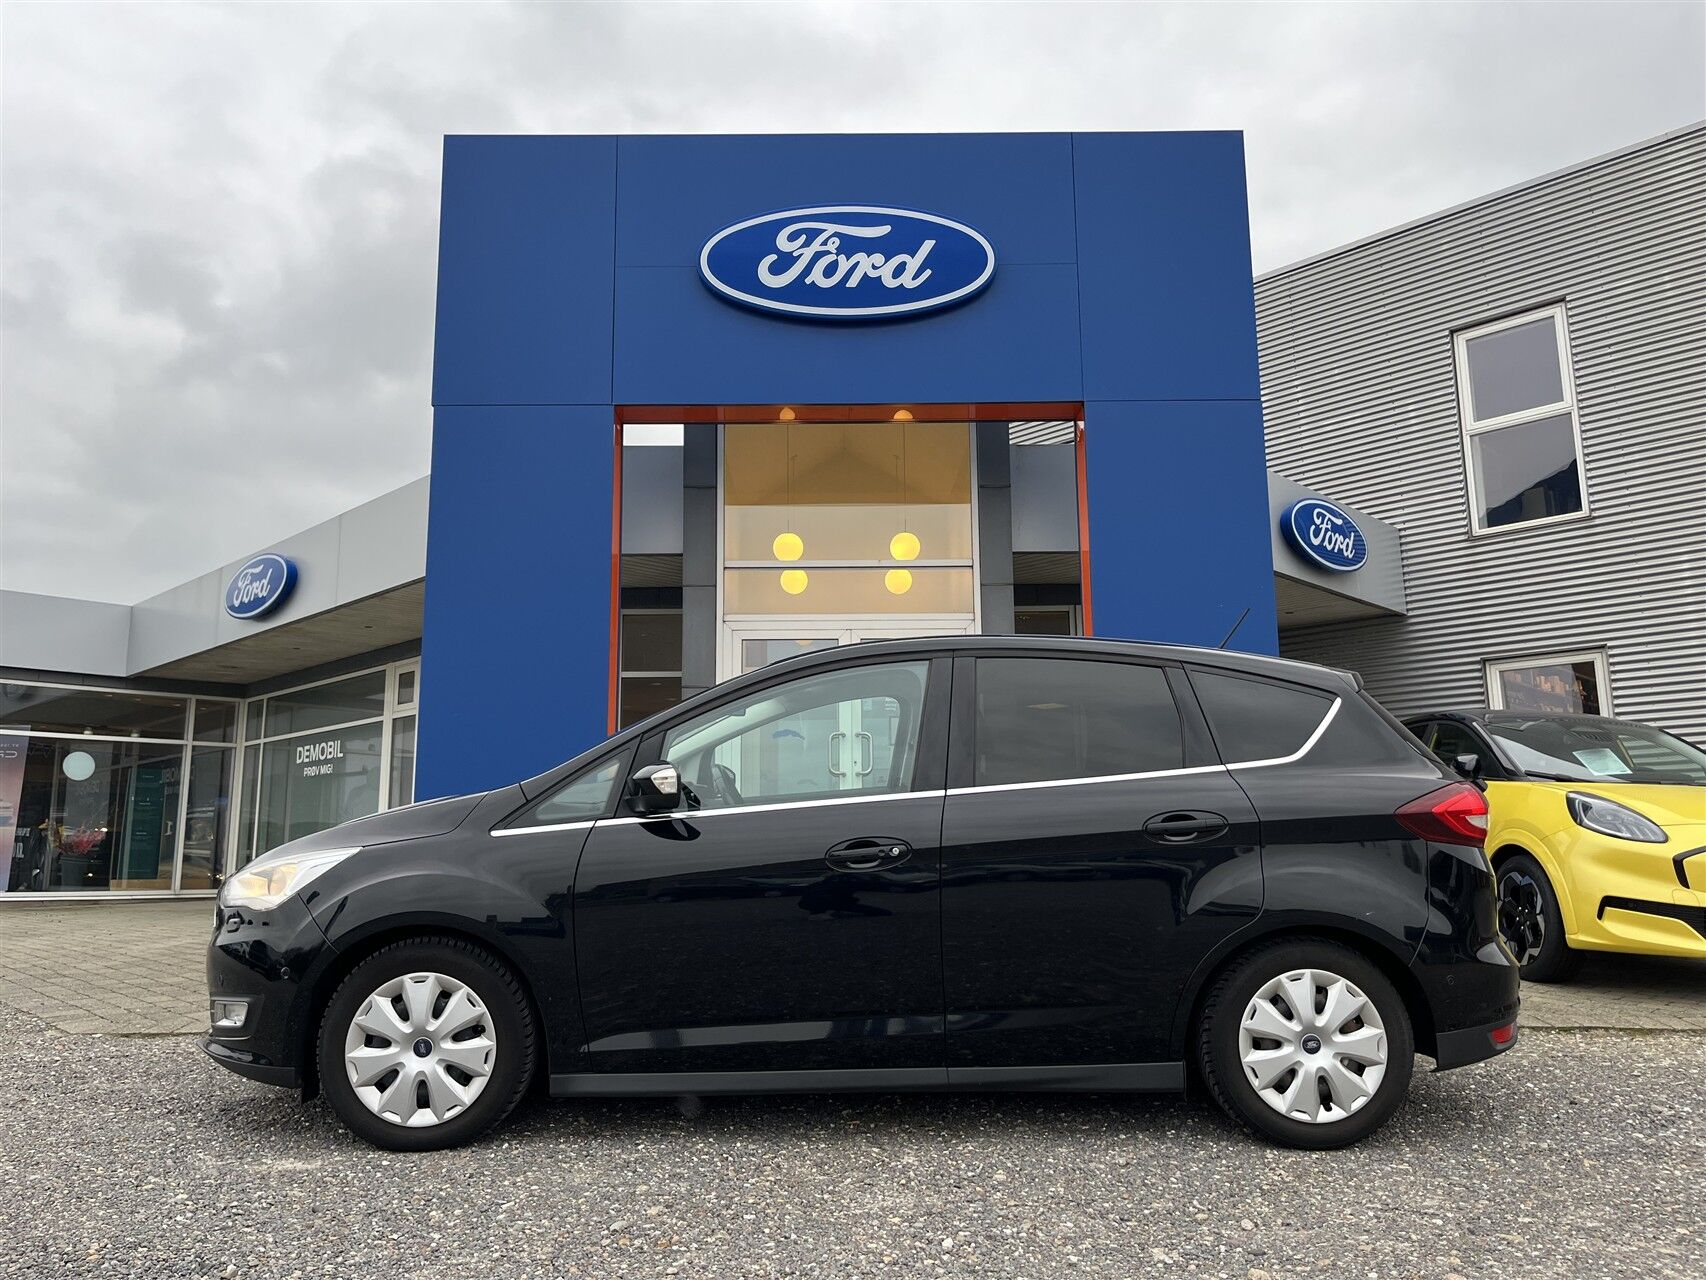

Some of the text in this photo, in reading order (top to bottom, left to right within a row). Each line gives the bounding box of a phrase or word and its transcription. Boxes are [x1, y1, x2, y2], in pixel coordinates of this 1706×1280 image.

[757, 222, 936, 289] Ford
[1309, 507, 1355, 559] Ford
[233, 564, 273, 607] Ford
[296, 740, 344, 764] DEMOBIL
